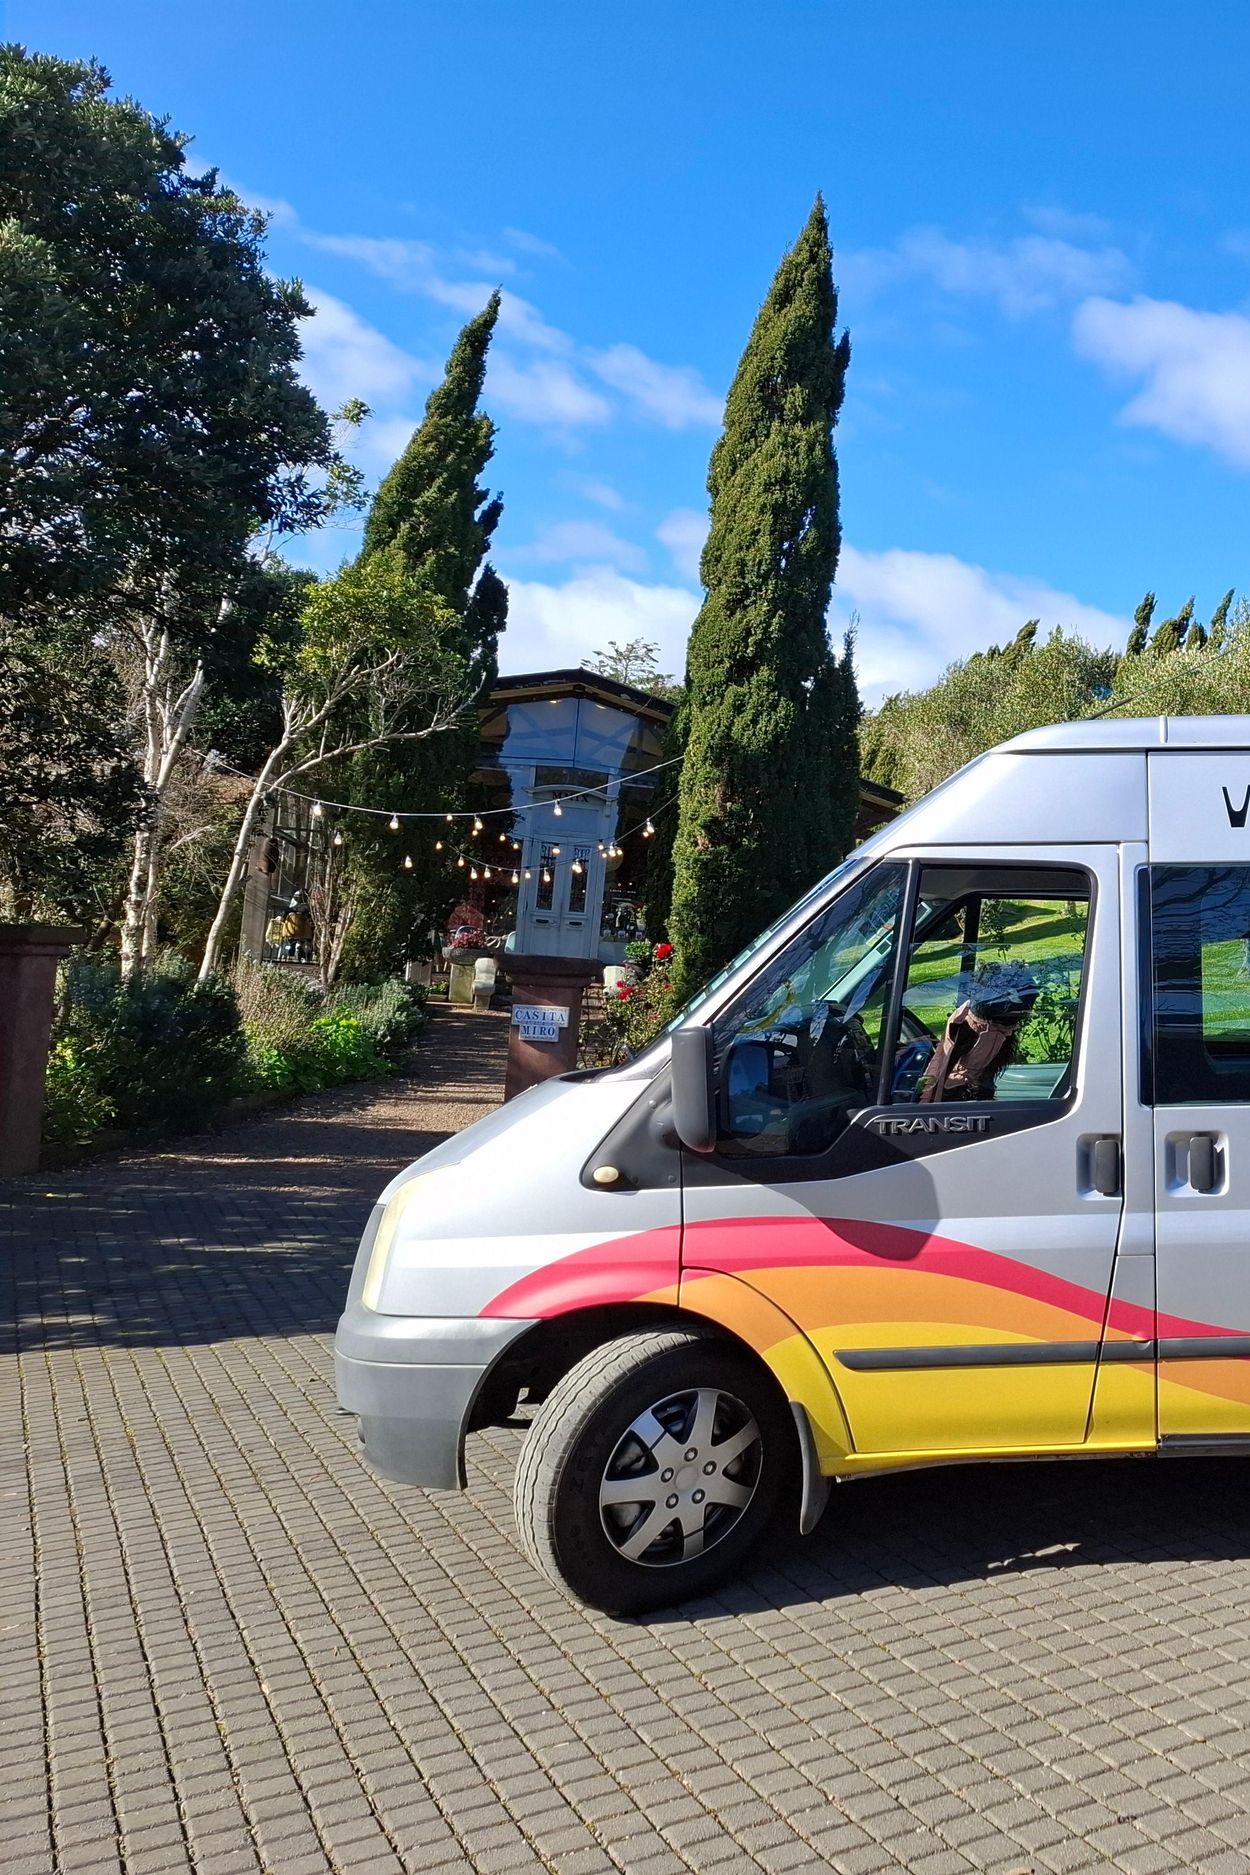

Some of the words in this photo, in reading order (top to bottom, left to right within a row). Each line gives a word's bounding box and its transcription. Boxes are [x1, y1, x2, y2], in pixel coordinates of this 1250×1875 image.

[515, 1010, 565, 1022] CASITA
[522, 1025, 555, 1036] MIRO
[873, 1115, 991, 1135] TRANSIT
